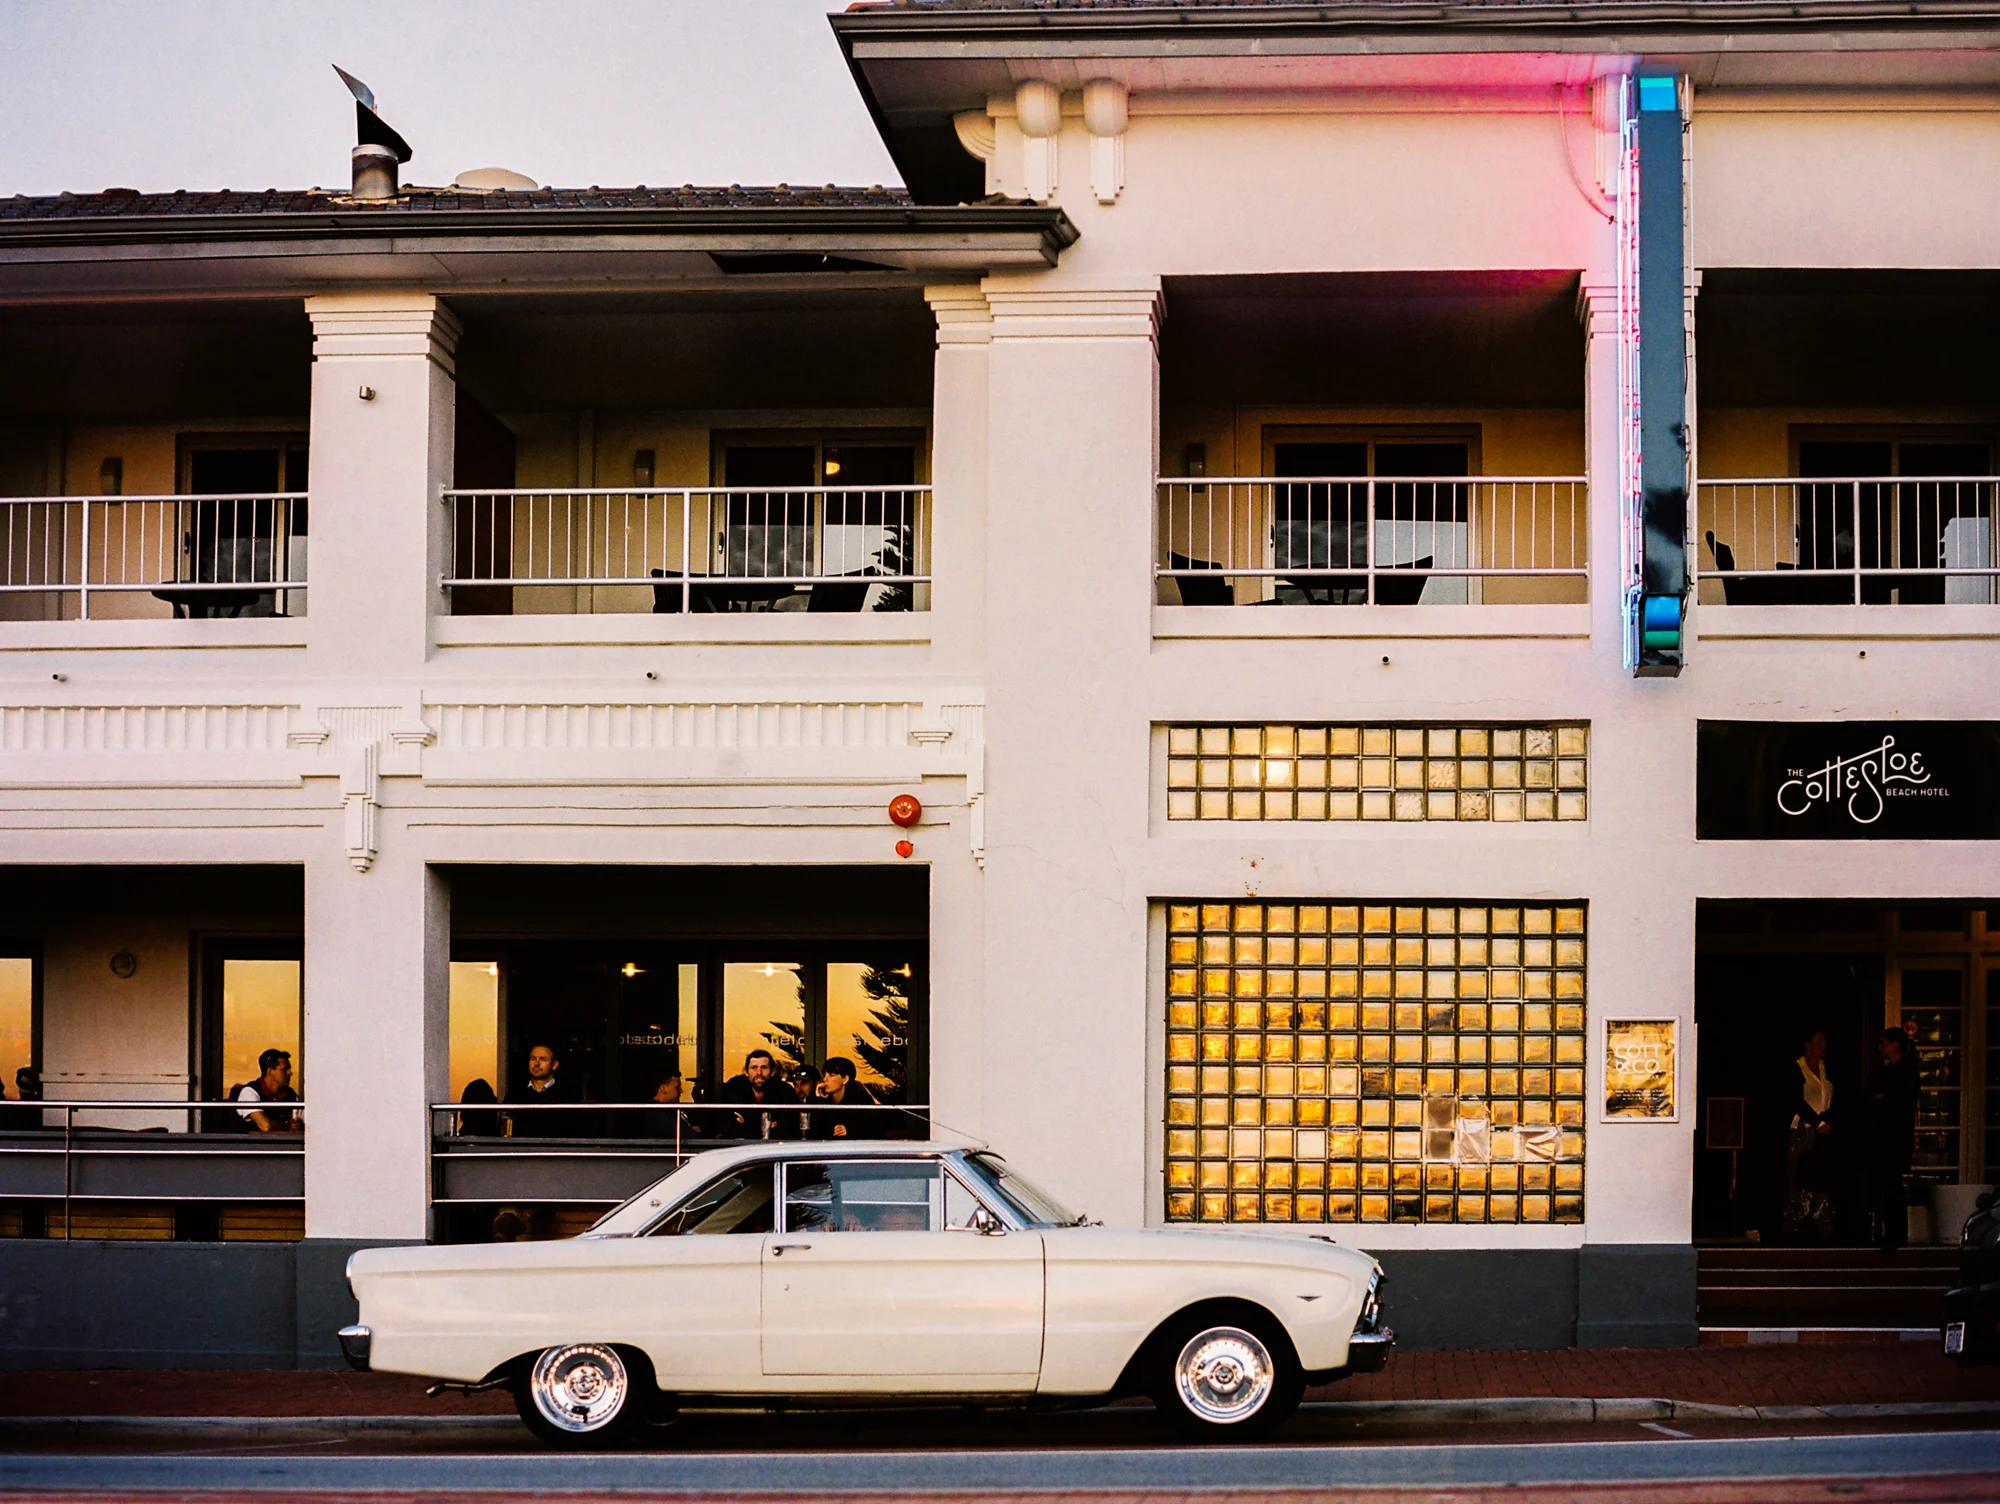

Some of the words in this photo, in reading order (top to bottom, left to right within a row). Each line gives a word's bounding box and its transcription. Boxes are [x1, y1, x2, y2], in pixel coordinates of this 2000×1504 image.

[1787, 768, 1804, 777] THE
[1886, 788, 1917, 796] BEACH
[1920, 788, 1950, 796] HOTEL
[1615, 1044, 1661, 1059] COTT
